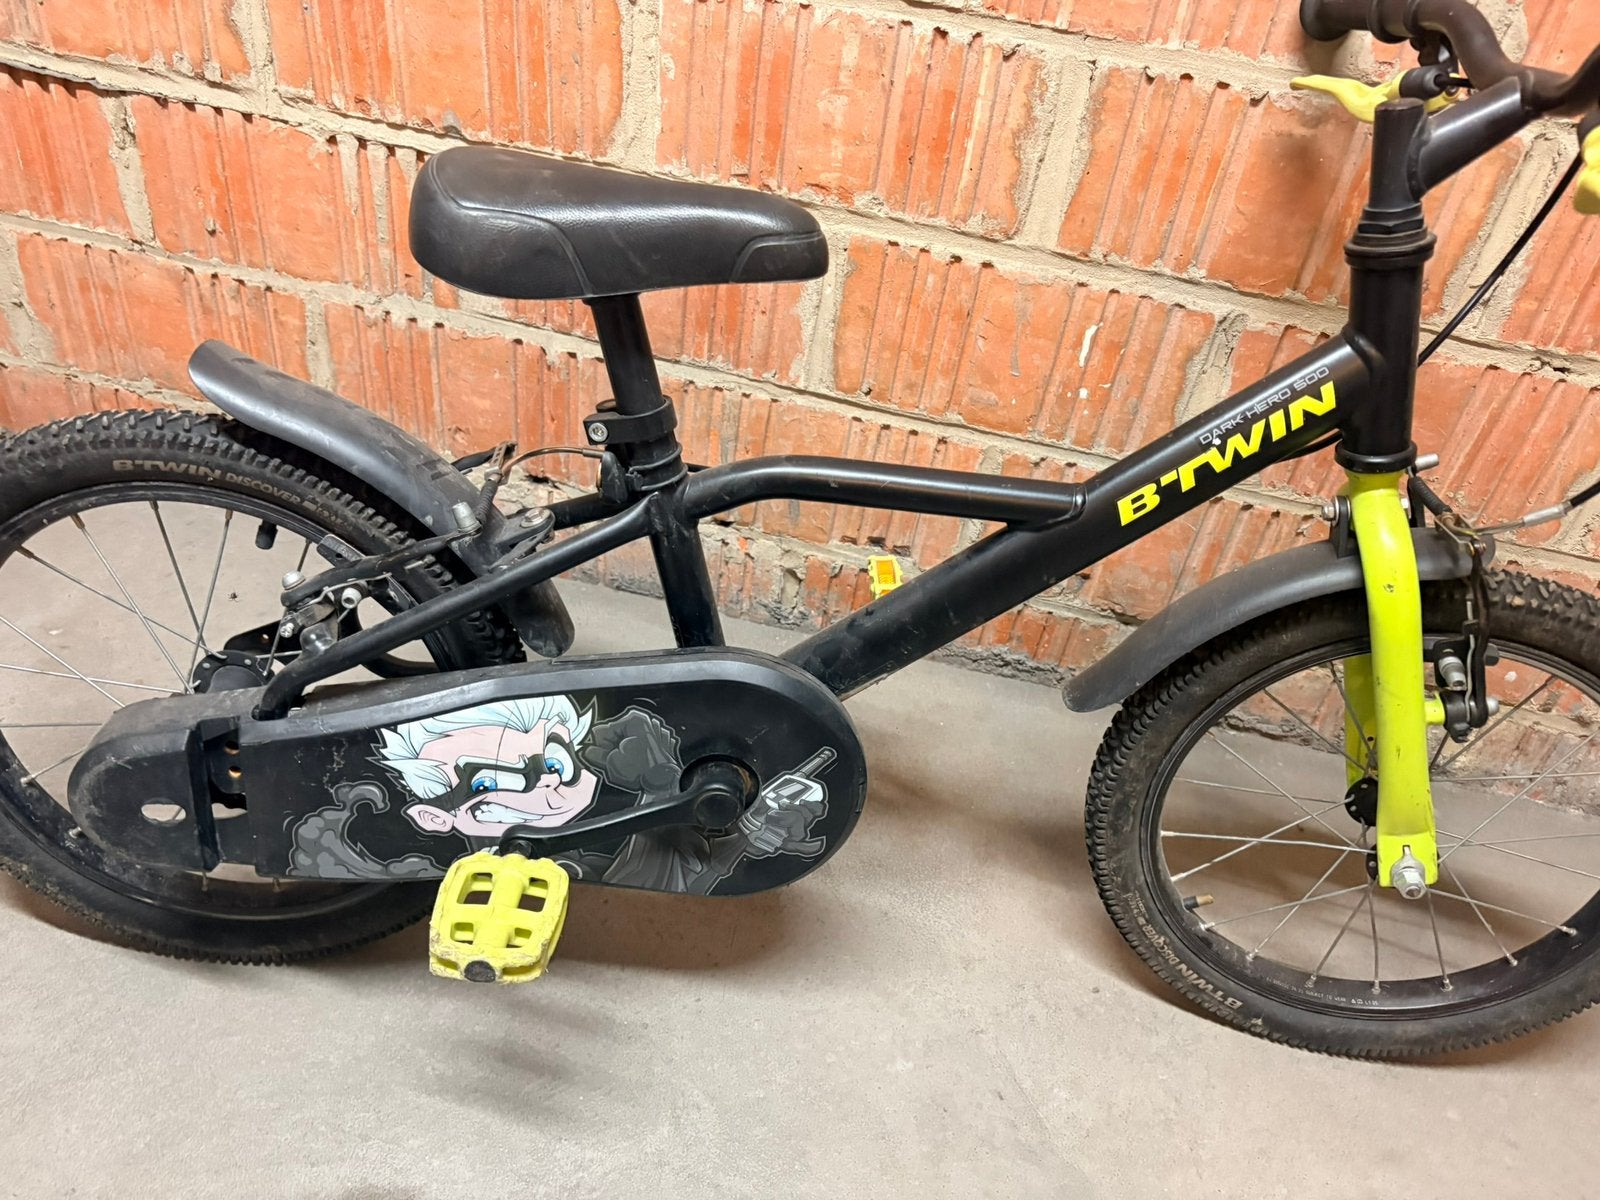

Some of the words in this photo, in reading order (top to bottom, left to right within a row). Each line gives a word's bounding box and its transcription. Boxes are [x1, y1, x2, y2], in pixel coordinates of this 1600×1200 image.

[1200, 414, 1245, 446] DARK
[1246, 389, 1291, 418] HERO
[1294, 366, 1330, 391] 500
[226, 473, 301, 505] DISCOVER
[1143, 924, 1180, 965] DISCOVER
